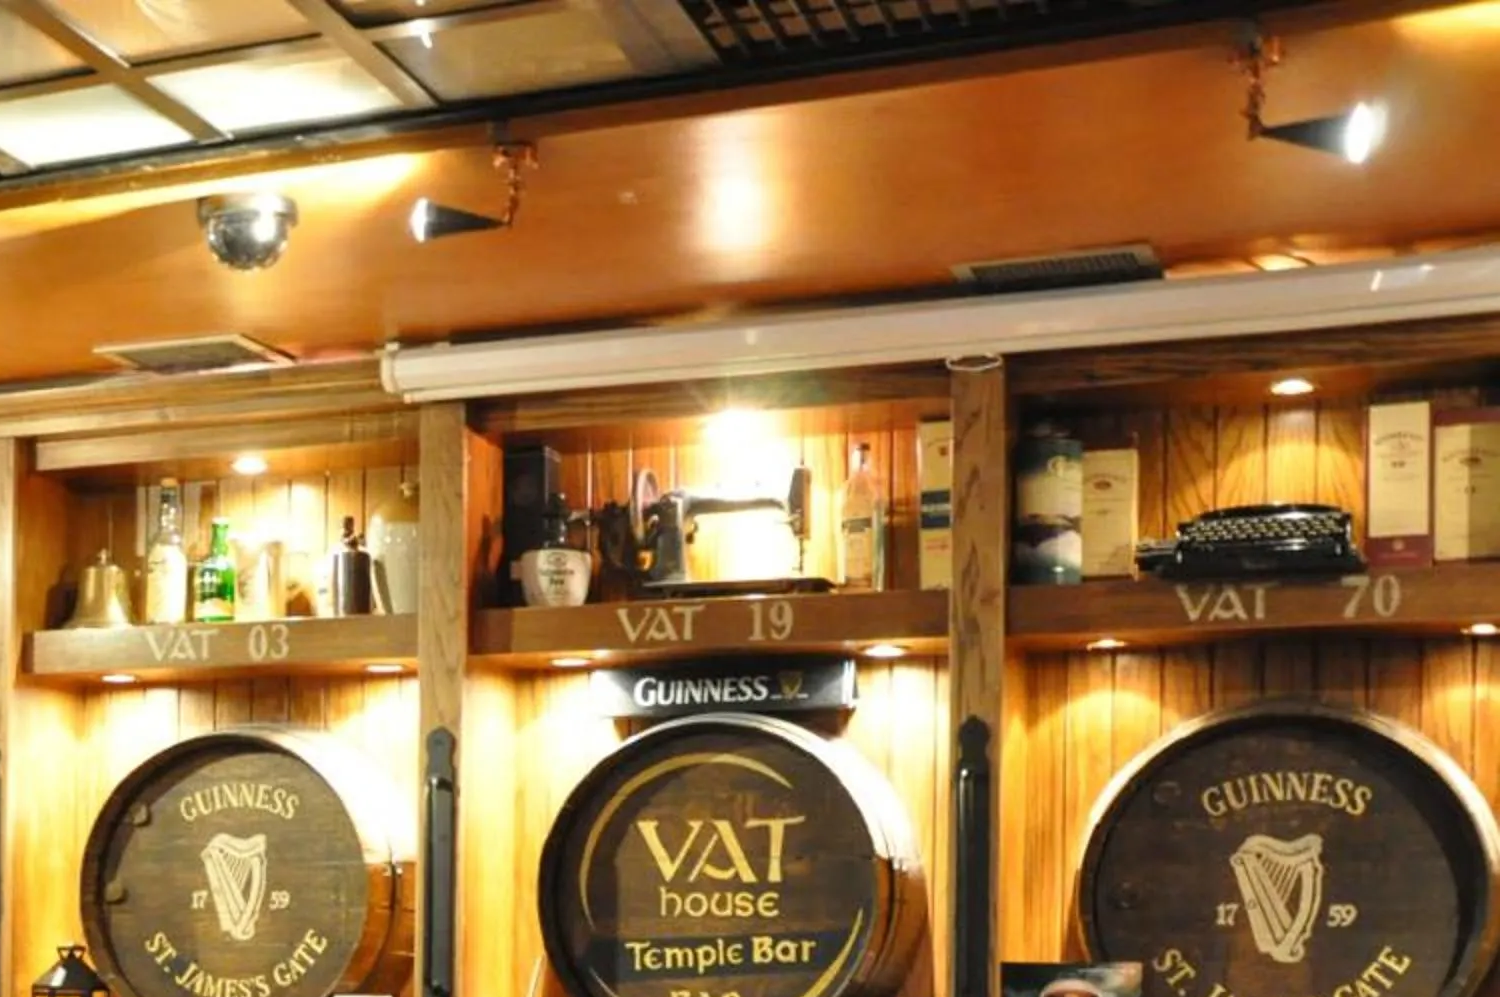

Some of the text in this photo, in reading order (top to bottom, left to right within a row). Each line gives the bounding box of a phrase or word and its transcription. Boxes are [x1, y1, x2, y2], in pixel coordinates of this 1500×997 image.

[1176, 574, 1401, 622] VAT 70
[617, 602, 794, 643] VAT 19
[144, 624, 290, 662] VAT 03
[633, 676, 771, 707] GUINNESS
[180, 783, 300, 822] GUINNESS
[1202, 772, 1373, 817] GUINNESS
[637, 815, 806, 884] VAT
[191, 890, 291, 910] 17 59
[1216, 903, 1358, 927] 17 59
[144, 931, 178, 973] ST.
[272, 928, 328, 988] GATE
[625, 935, 816, 974] Temple Bar
[1152, 948, 1197, 997] ST.
